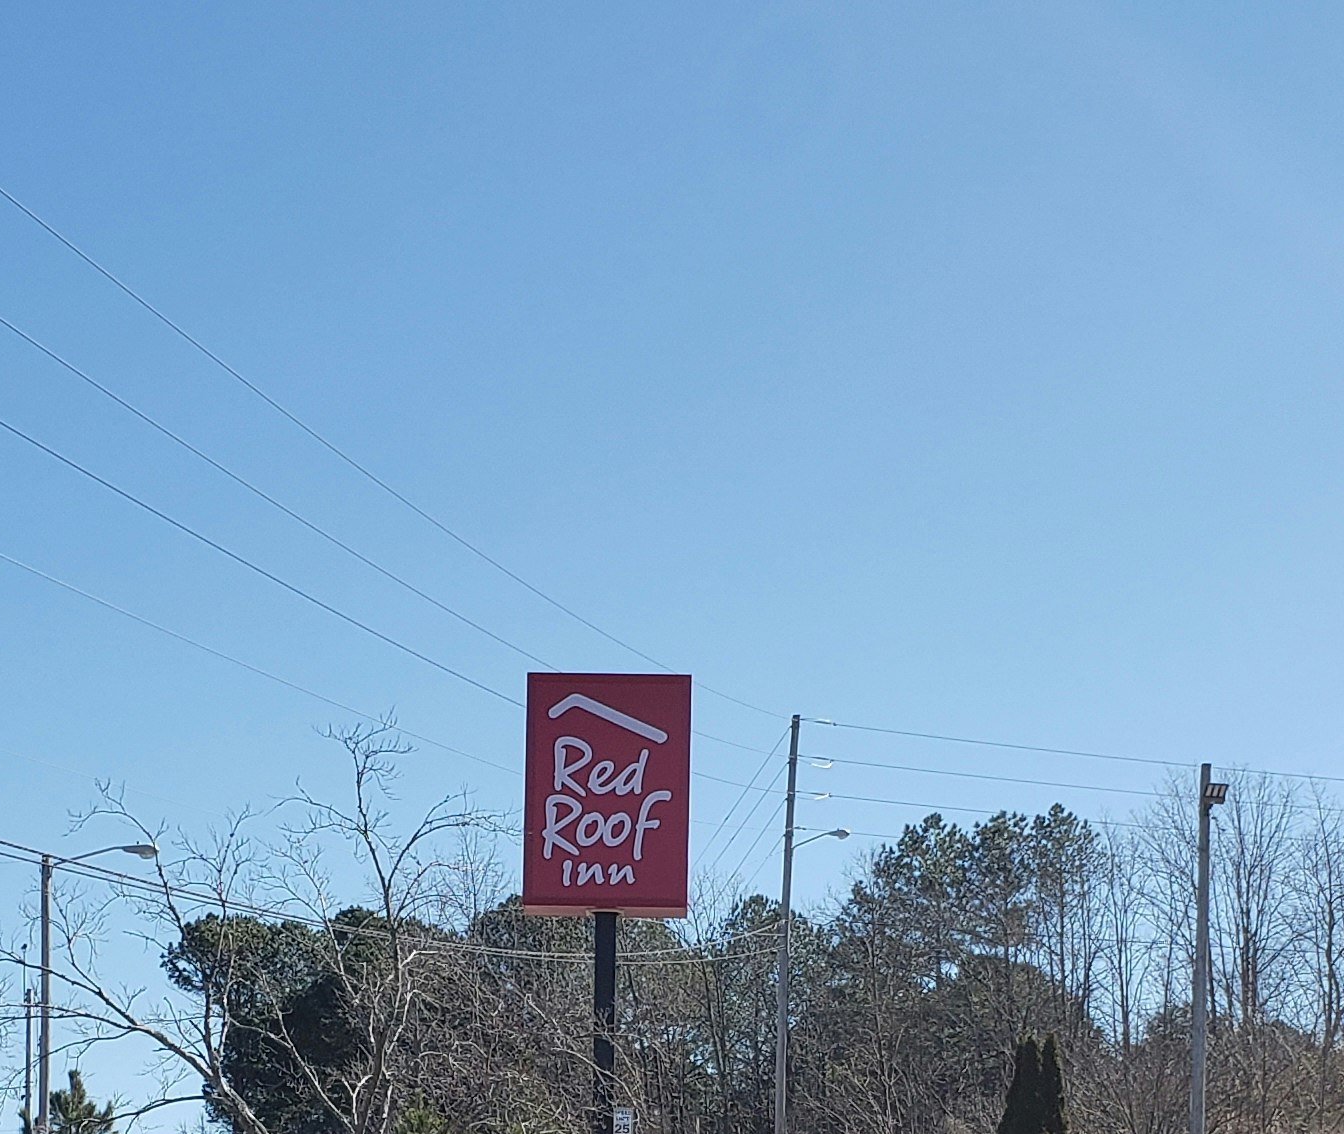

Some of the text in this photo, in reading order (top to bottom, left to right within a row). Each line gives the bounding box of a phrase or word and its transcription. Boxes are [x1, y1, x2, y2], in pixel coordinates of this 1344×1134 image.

[554, 735, 649, 797] Red
[542, 790, 672, 861] Roof
[562, 859, 636, 887] Inn
[614, 1123, 630, 1134] 25
